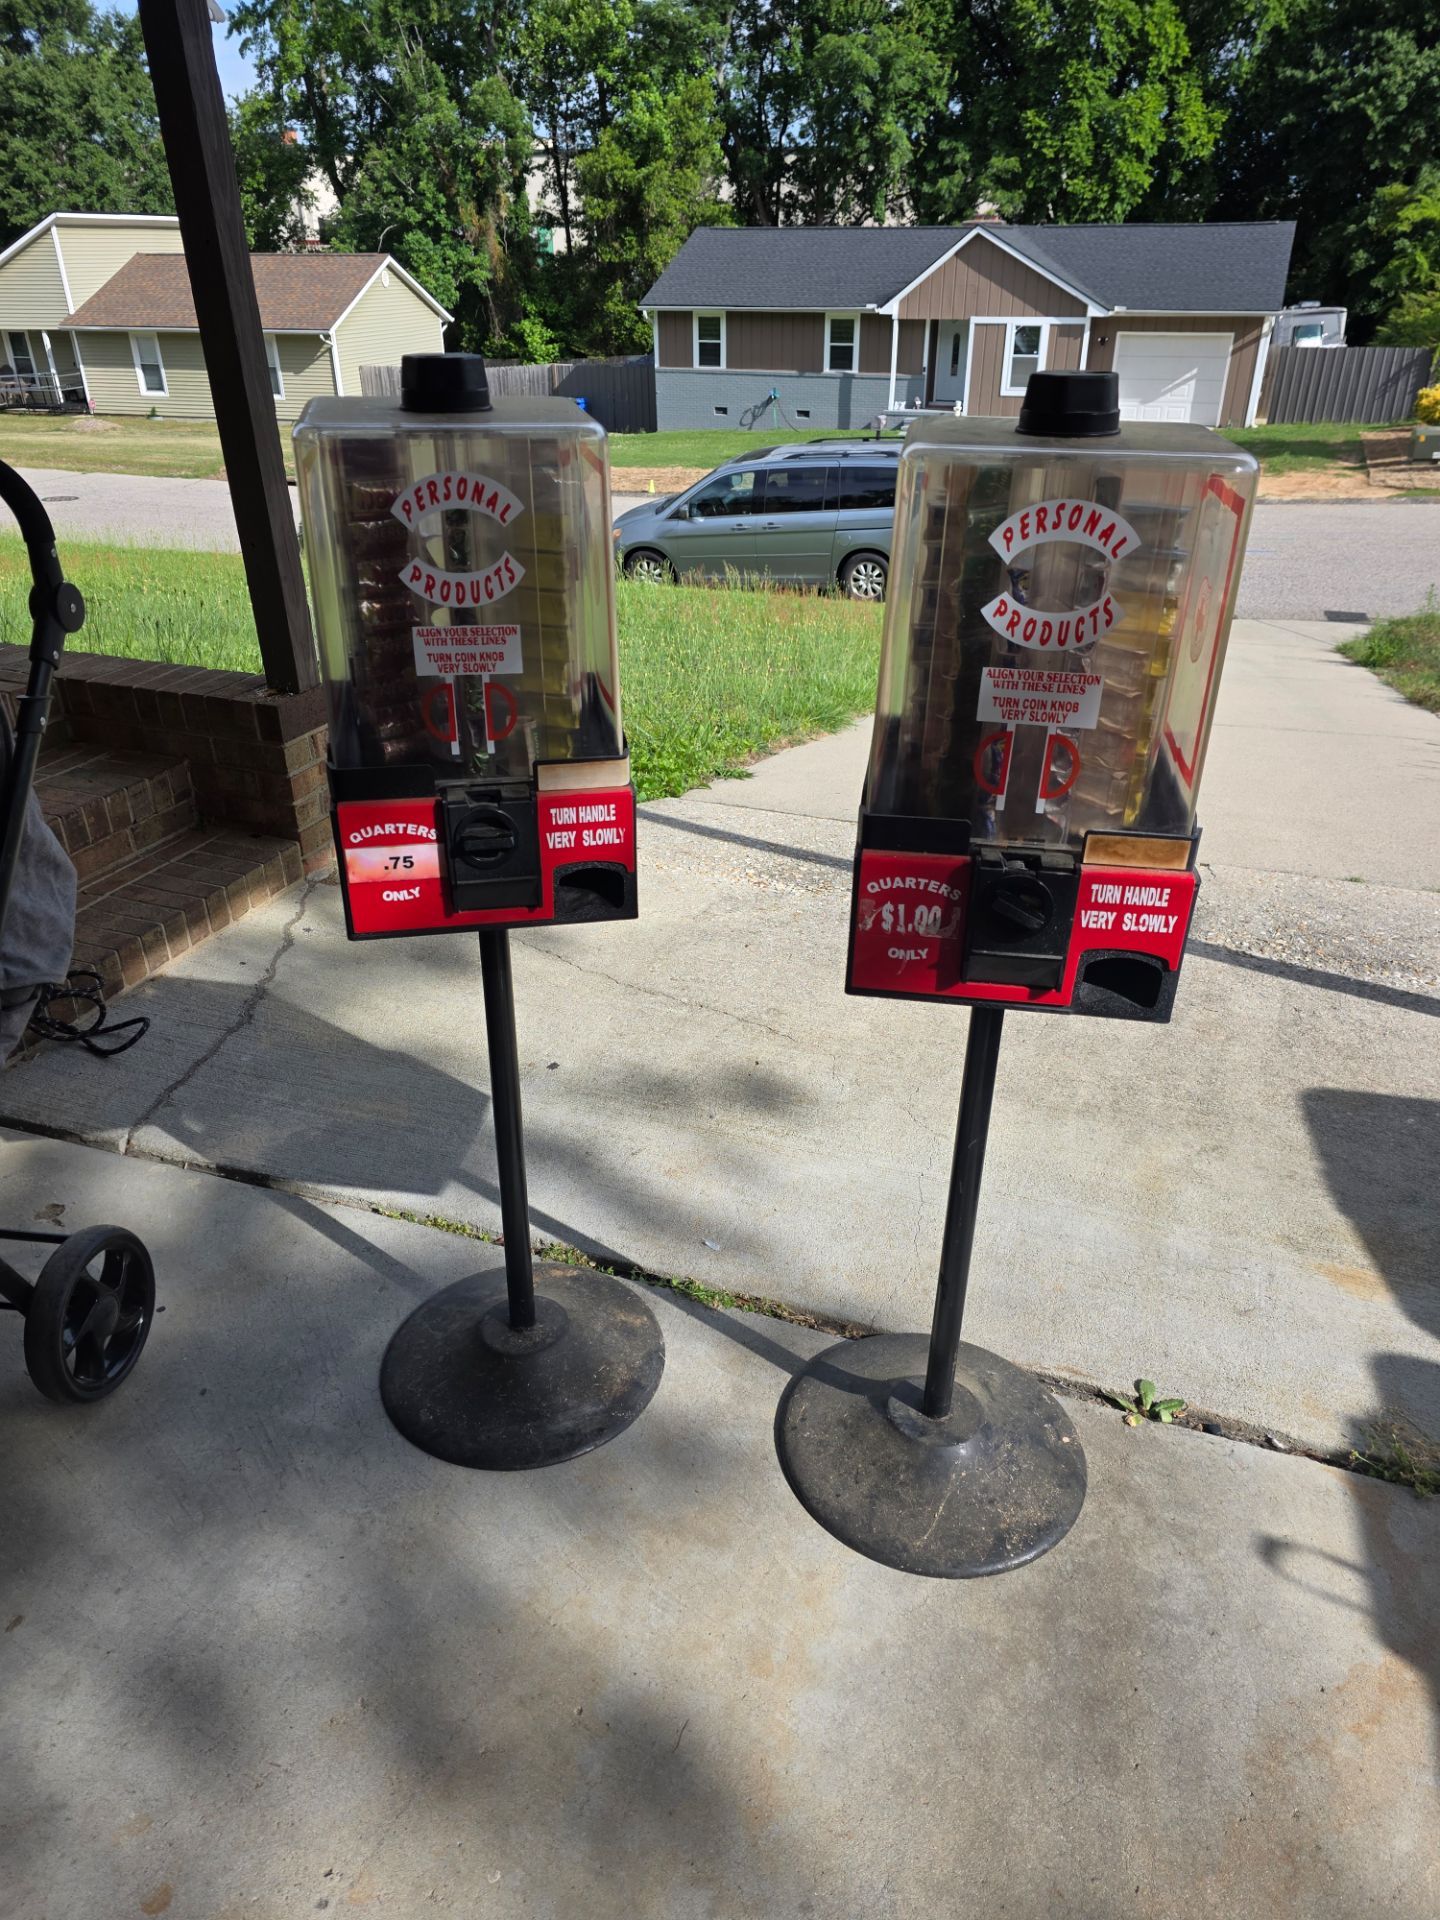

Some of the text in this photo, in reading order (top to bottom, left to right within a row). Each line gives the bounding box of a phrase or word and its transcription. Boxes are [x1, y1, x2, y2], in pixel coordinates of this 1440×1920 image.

[401, 475, 512, 524] PERSONAL
[1002, 502, 1128, 559] PERSONAL
[409, 556, 516, 605] PRODUCTS
[992, 596, 1114, 647] PRODUCTS
[415, 626, 518, 638] ALIGN YOUR SELECTION
[423, 636, 507, 647] WITH THESE LINES
[426, 651, 505, 663] TURN COIN KNOB
[437, 662, 497, 674] VERY SLOWLY
[986, 668, 1102, 686] ALIGN YOUR SELECTION
[992, 680, 1086, 695] WITH THESE LINES
[992, 696, 1080, 713] TURN COIN KNOB
[1001, 709, 1069, 724] VERY SLOWLY
[550, 804, 617, 825] TURN HANDLE
[349, 822, 438, 844] QUARTERS
[545, 827, 626, 849] VERY SLOWLY
[384, 855, 415, 871] .75
[382, 886, 421, 902] ONLY
[866, 876, 962, 900] QUARTERS
[1090, 884, 1171, 907] TURN HANDLE
[881, 900, 942, 936] $1.00
[1080, 910, 1178, 934] VERY SLOWLY
[887, 947, 929, 961] ONLY
